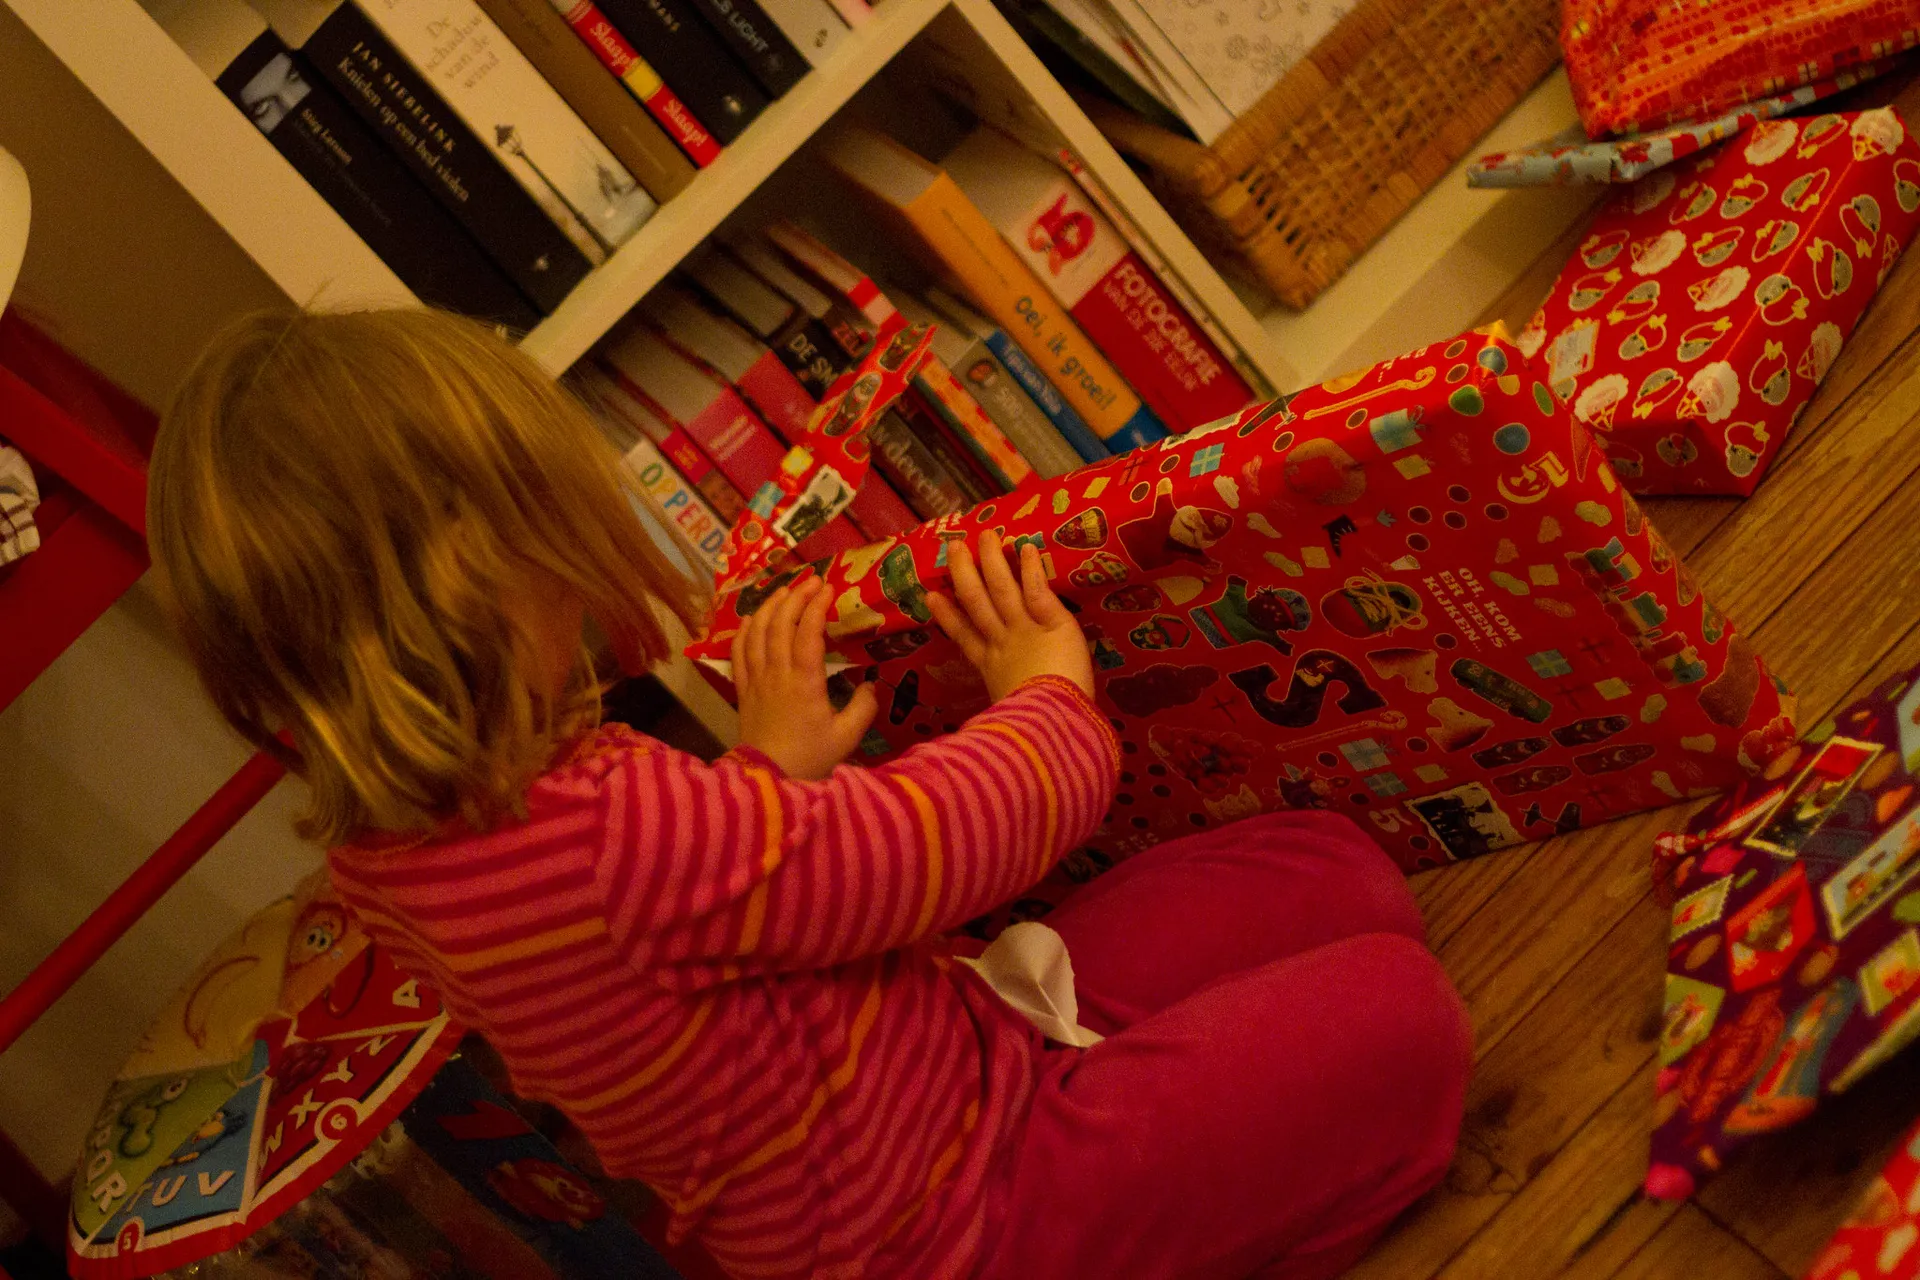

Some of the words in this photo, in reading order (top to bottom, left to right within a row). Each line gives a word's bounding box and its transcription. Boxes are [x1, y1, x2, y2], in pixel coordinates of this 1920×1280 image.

[352, 40, 383, 73] JAN
[375, 104, 397, 128] op
[414, 139, 440, 166] bed
[1046, 331, 1067, 357] ik
[638, 461, 730, 560] OPPERD
[1438, 568, 1465, 599] ER
[1462, 599, 1507, 651] EENS
[1456, 566, 1485, 599] OH,
[1484, 598, 1523, 645] KOM
